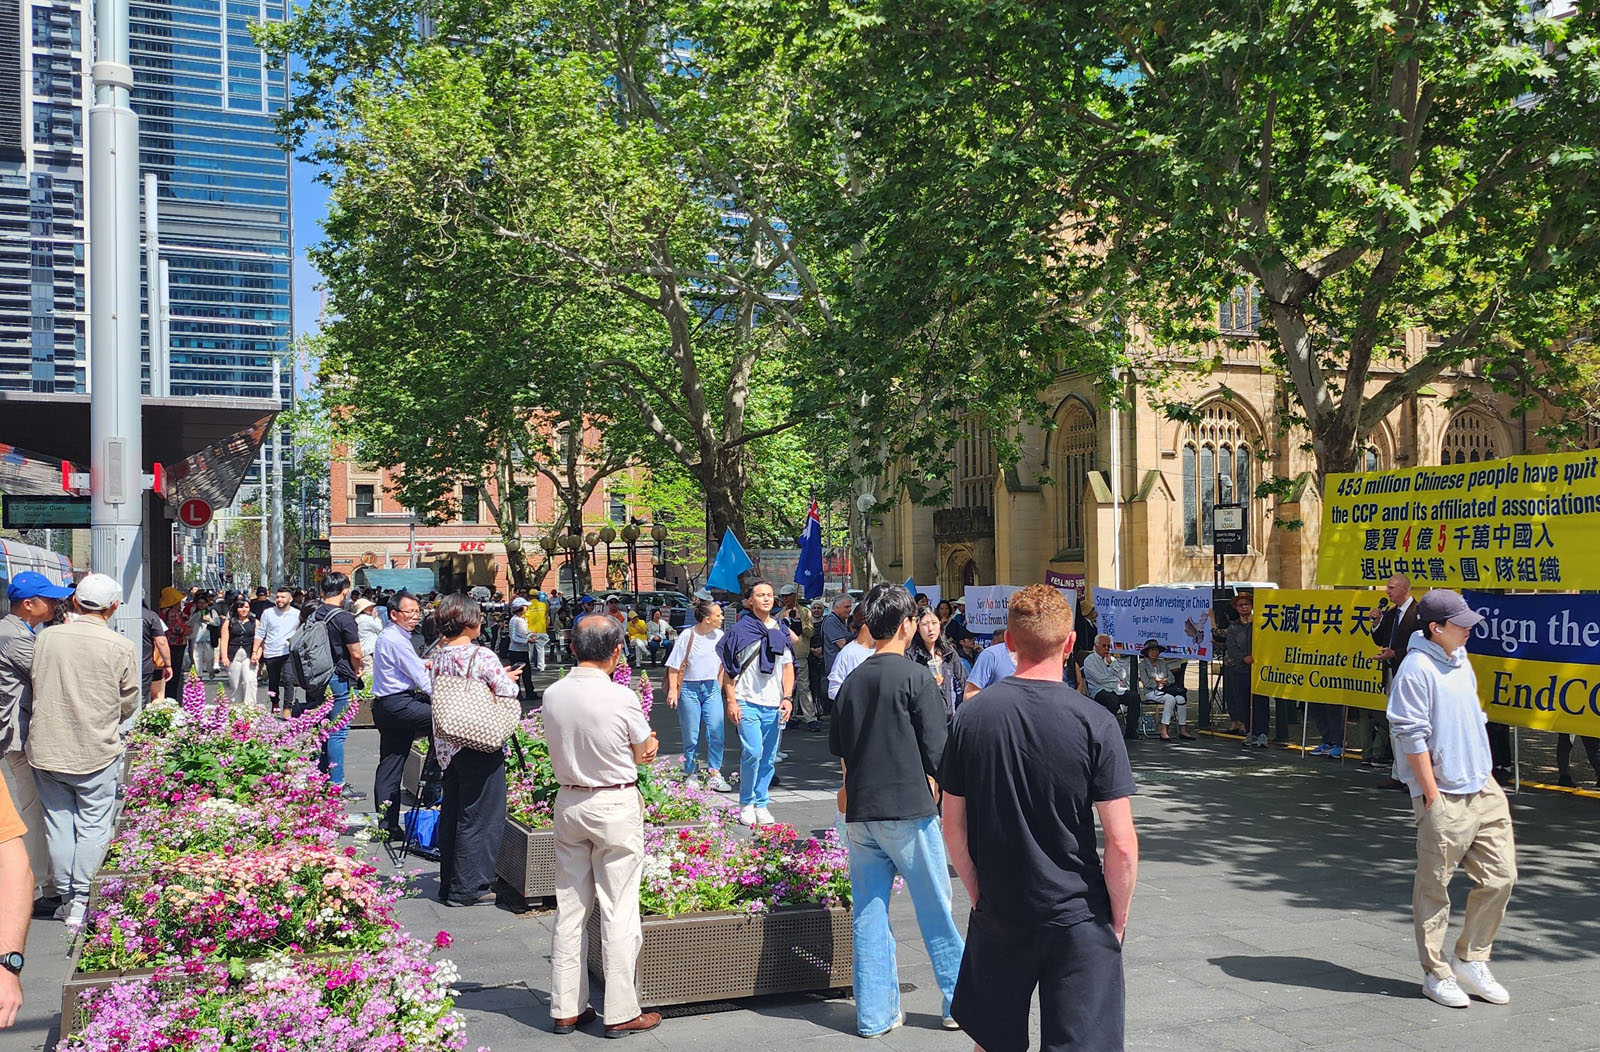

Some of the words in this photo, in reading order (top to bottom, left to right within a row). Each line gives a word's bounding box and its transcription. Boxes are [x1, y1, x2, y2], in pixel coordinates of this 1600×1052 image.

[1337, 477, 1362, 496] 453
[1364, 474, 1411, 495] million
[1414, 471, 1465, 491] Chinese
[1467, 462, 1518, 492] people
[1523, 462, 1558, 483] have
[1564, 456, 1599, 485] quit
[189, 503, 202, 521] L
[1332, 505, 1349, 524] the
[1352, 503, 1378, 523] CCP
[1382, 501, 1410, 522] and
[1412, 501, 1427, 520] its
[1431, 495, 1497, 520] affiliated
[1502, 492, 1600, 516] associations
[459, 541, 487, 552] KFC
[986, 597, 994, 610] No
[995, 598, 1001, 609] to
[1096, 595, 1110, 609] Stop
[1111, 595, 1132, 607] Forced
[1133, 595, 1153, 610] Organ
[1154, 596, 1185, 611] Harvesting
[1186, 598, 1191, 607] in
[1192, 598, 1209, 609] China
[988, 612, 1002, 625] from
[1131, 615, 1141, 625] Sign
[1260, 603, 1344, 635] 天滅中共
[1475, 607, 1538, 653] Sign
[1547, 609, 1600, 647] the
[1284, 646, 1348, 667] Eliminate
[1352, 650, 1372, 669] the
[1260, 665, 1304, 686] Chinese
